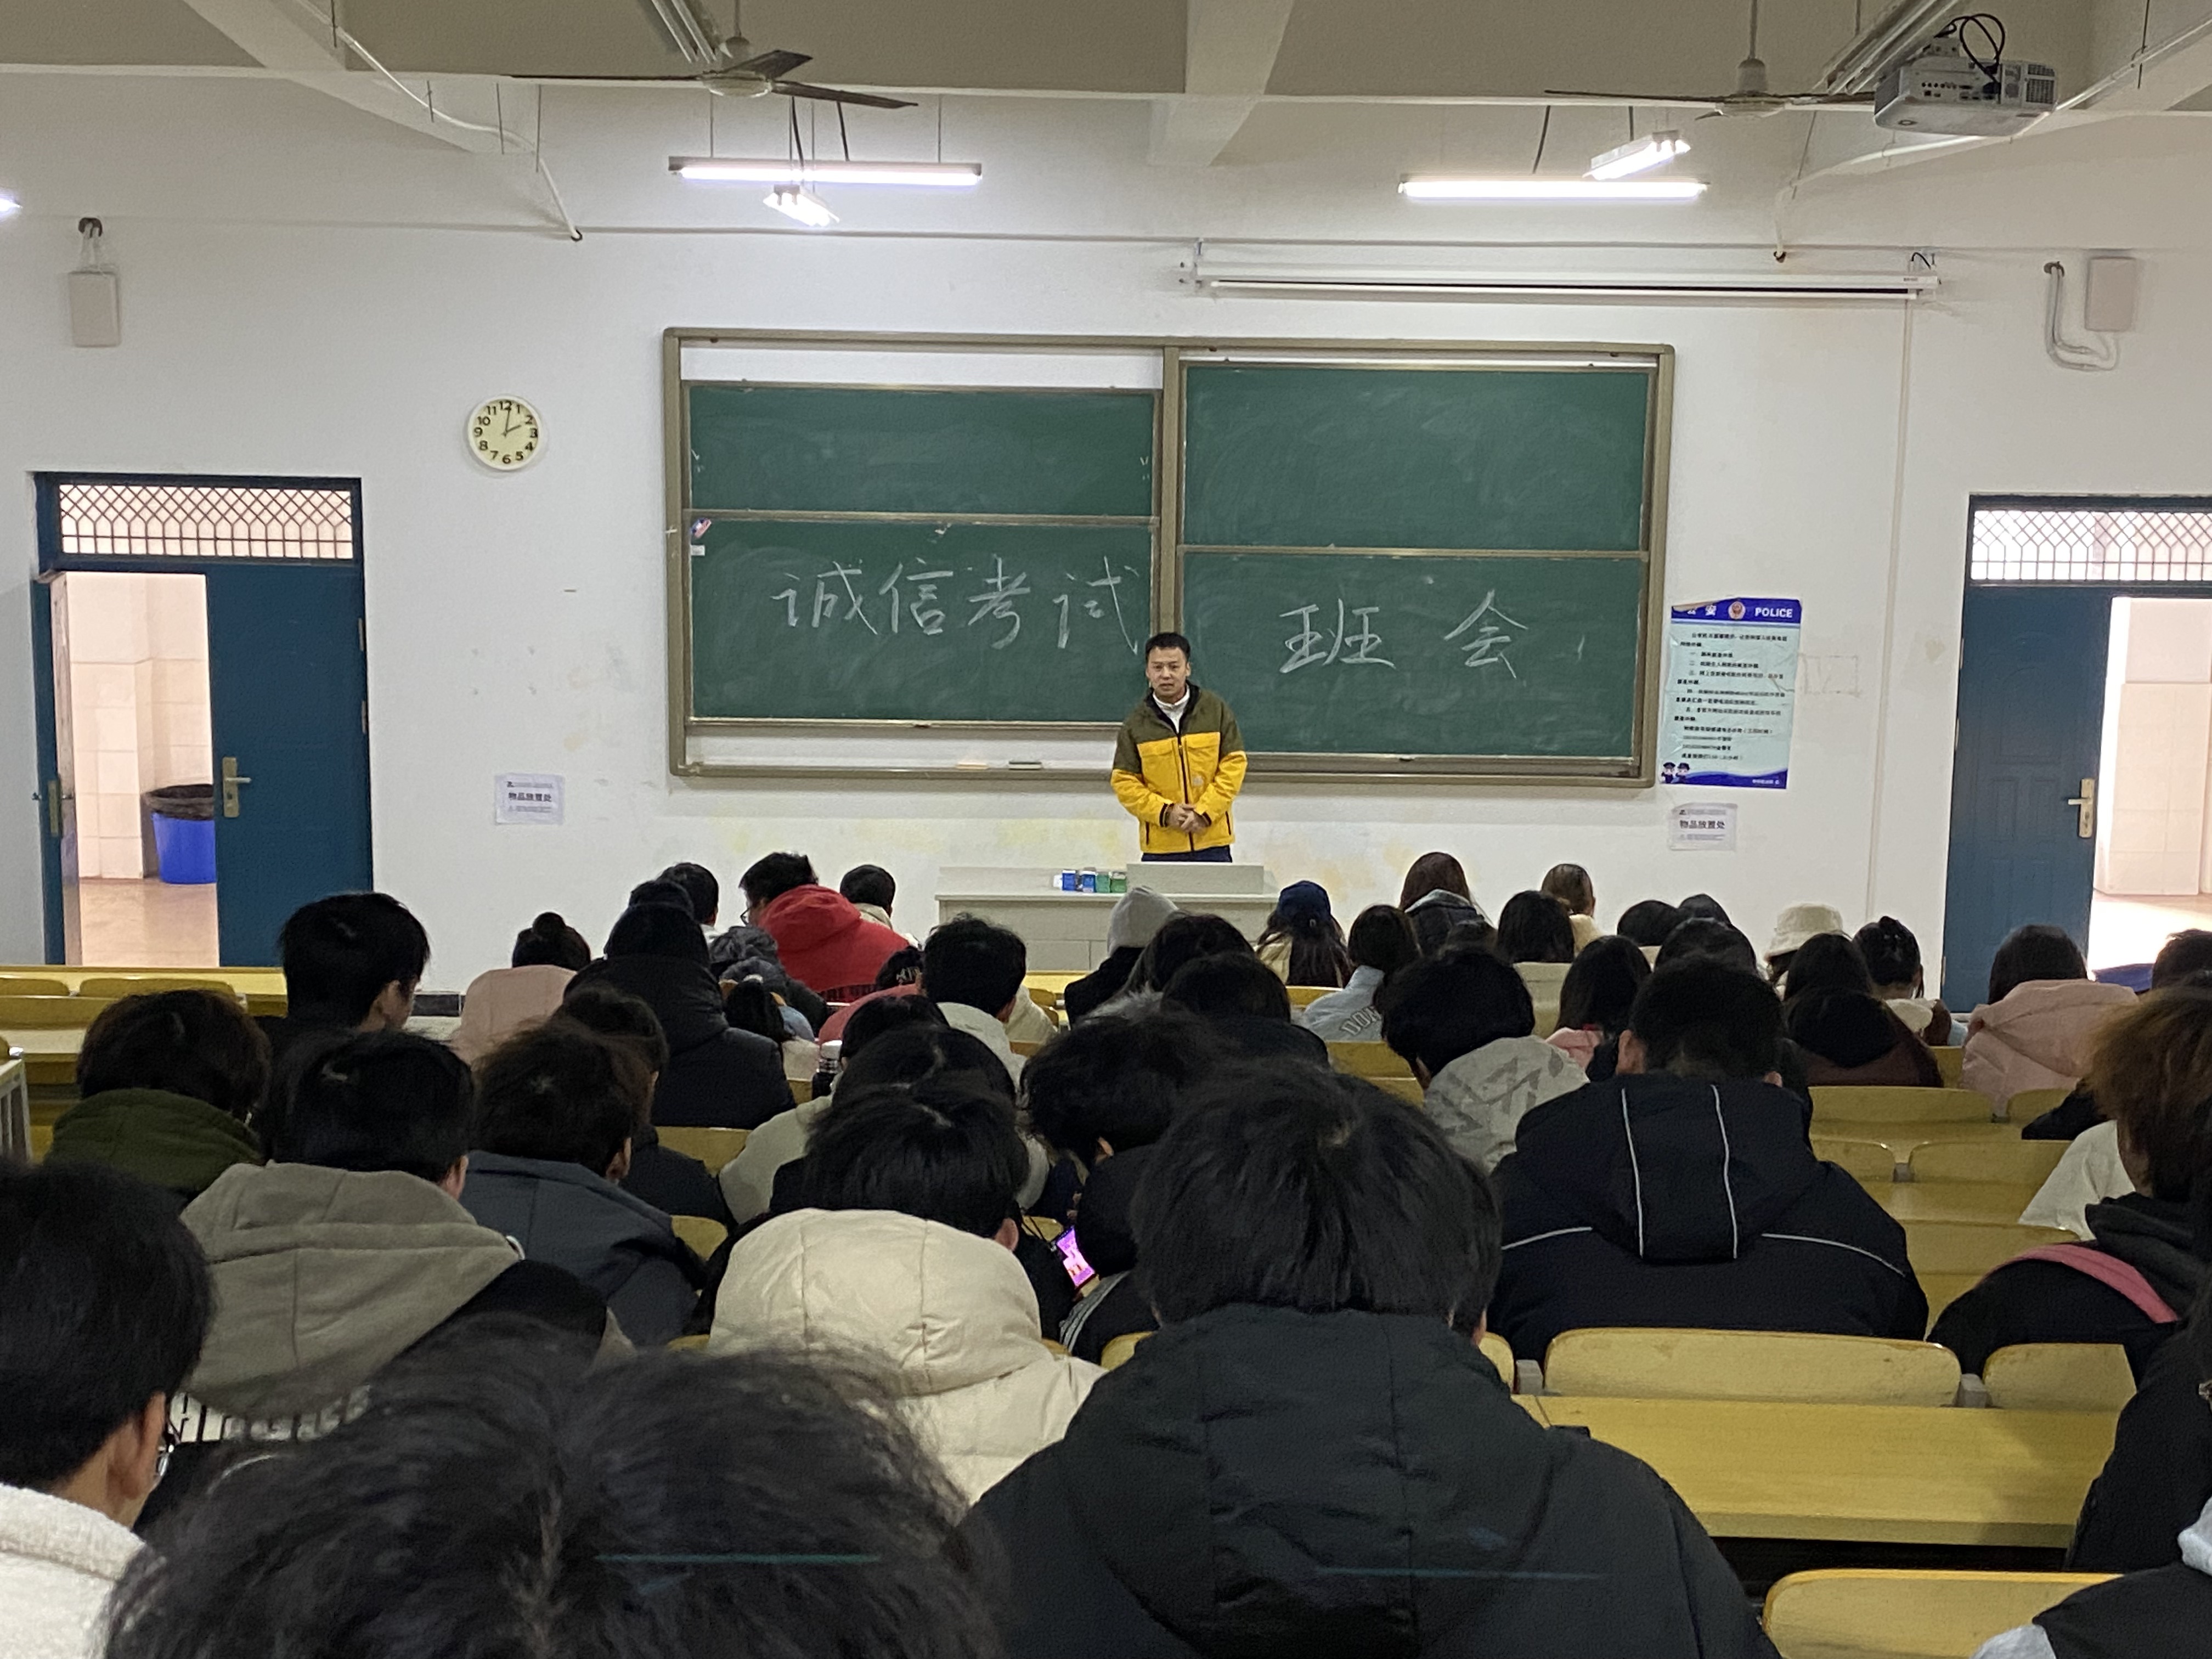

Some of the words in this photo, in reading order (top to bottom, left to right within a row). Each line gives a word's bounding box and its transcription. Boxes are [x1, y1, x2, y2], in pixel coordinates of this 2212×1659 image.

[486, 405, 496, 415] 11
[499, 400, 512, 410] 12
[516, 404, 521, 414] 1
[477, 416, 490, 426] 10
[525, 415, 533, 425] 2
[474, 427, 483, 437] 9
[529, 428, 538, 438] 3
[479, 440, 488, 450] 8
[524, 442, 533, 451] 4
[490, 450, 498, 460] 7
[502, 454, 511, 464] 6
[515, 451, 524, 461] 5
[771, 555, 1139, 655] 诚信考试
[1279, 589, 1528, 679] 班会
[1754, 607, 1793, 618] POLICE
[1679, 820, 1725, 830] 物品放置处
